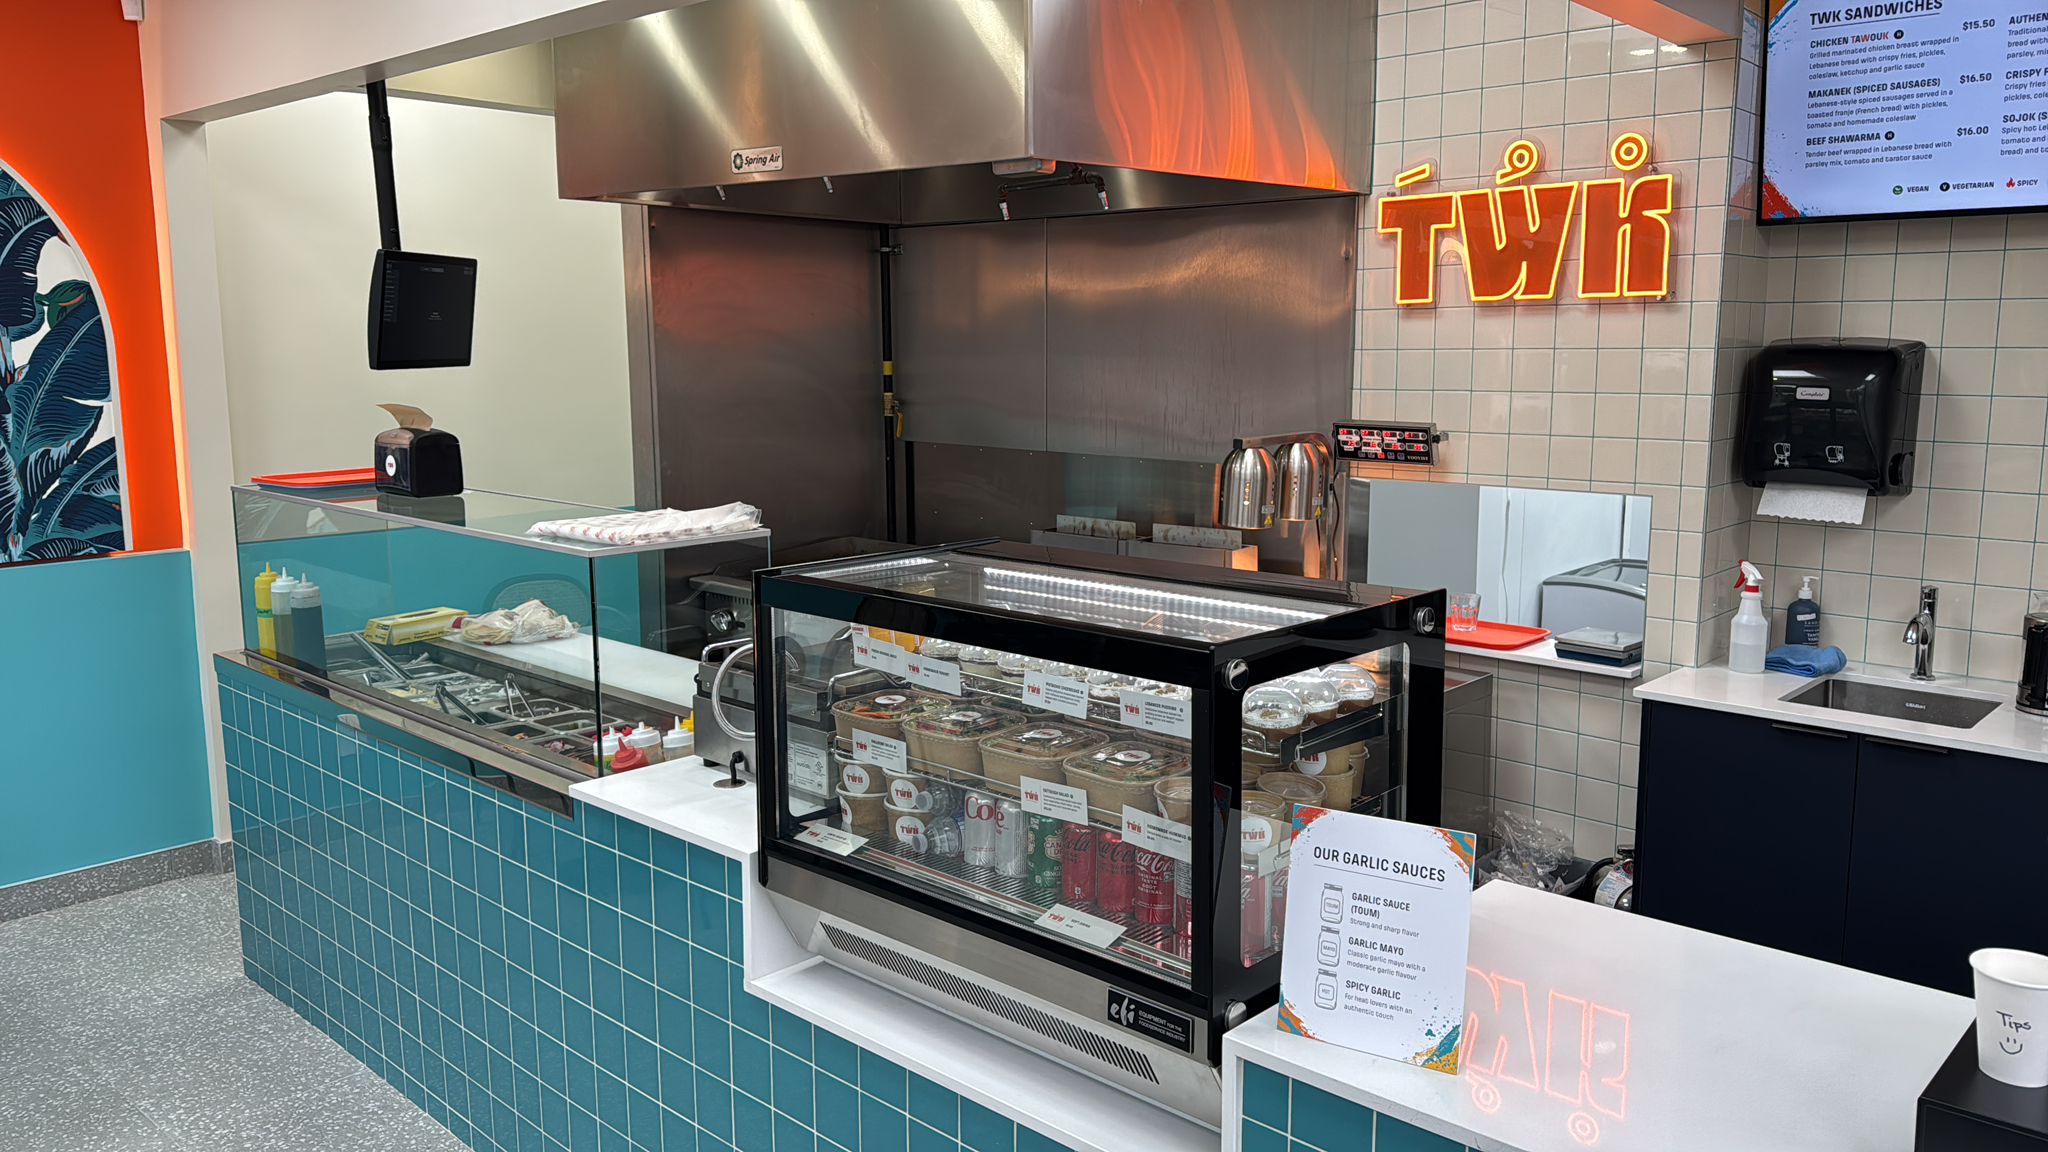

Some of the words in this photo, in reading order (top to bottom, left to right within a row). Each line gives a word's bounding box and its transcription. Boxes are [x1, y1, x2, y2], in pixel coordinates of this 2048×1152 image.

[1810, 10, 1842, 25] TWK
[1844, 0, 1943, 20] SANDWICHES
[1962, 18, 1996, 31] $15.50
[1810, 36, 1849, 48] CHICKEN
[1851, 31, 1889, 44] TAWOUK
[1832, 46, 1866, 56] marinated
[1868, 44, 1895, 52] chicken
[1920, 36, 1951, 46] wrapped
[2008, 39, 2029, 48] bread
[1809, 61, 1839, 69] Lebanese
[1840, 58, 1859, 66] bread
[1919, 49, 1945, 58] pickles,
[2006, 50, 2035, 60] parsley,
[1840, 68, 1868, 76] ketchup
[1883, 64, 1903, 73] garlic
[2006, 68, 2042, 80] CRISPY
[1960, 72, 1992, 84] $16.50
[2030, 80, 2046, 88] fries
[1808, 87, 1851, 98] MAKANEK
[1854, 83, 1887, 95] (SPICED
[1890, 78, 1940, 91] SAUSAGES)
[1808, 99, 1857, 108] Lebanese-style
[1882, 93, 1914, 101] sausages
[2004, 94, 2032, 103] pickles,
[1881, 104, 1902, 112] bread)
[1847, 117, 1884, 126] homemade
[2002, 112, 2036, 123] SOJOK
[1957, 126, 1989, 137] $16.00
[1806, 137, 1826, 146] BEEF
[1828, 133, 1880, 144] SHAWARMA
[1881, 144, 1912, 152] Lebanese
[744, 154, 768, 167] Spring
[769, 153, 780, 163] Air
[1952, 182, 1994, 190] VEGETARIAN
[847, 774, 864, 783] TWK
[895, 789, 912, 799] TWK
[900, 825, 919, 835] TWK
[1314, 846, 1340, 862] OUR
[1343, 852, 1389, 871] GARLIC
[1392, 861, 1446, 882] SAUCES
[1352, 892, 1381, 906] GARLIC
[1383, 898, 1411, 912] SAUCE
[1351, 905, 1380, 919] (TOUM)
[1350, 918, 1370, 928] Strong
[1384, 925, 1400, 934] sharp
[1402, 928, 1419, 937] flavor
[1348, 936, 1378, 950] GARLIC
[1380, 943, 1404, 956] MAYO
[1347, 949, 1368, 959] Classic
[1370, 954, 1387, 964] garlic
[1388, 959, 1404, 968] mayo
[1406, 962, 1420, 971] with
[1347, 960, 1376, 972] moderate
[1377, 966, 1394, 976] garlic
[1396, 971, 1417, 980] flavour
[1345, 980, 1369, 992] SPICY
[1371, 986, 1401, 1000] GARLIC
[1355, 995, 1368, 1004] heat
[1370, 999, 1388, 1009] lovers
[1389, 1002, 1404, 1012] with
[1139, 1010, 1166, 1026] EQUIPMENT
[1344, 1004, 1374, 1016] authentic
[1376, 1012, 1394, 1020] touch
[1996, 1010, 2032, 1032] Tips
